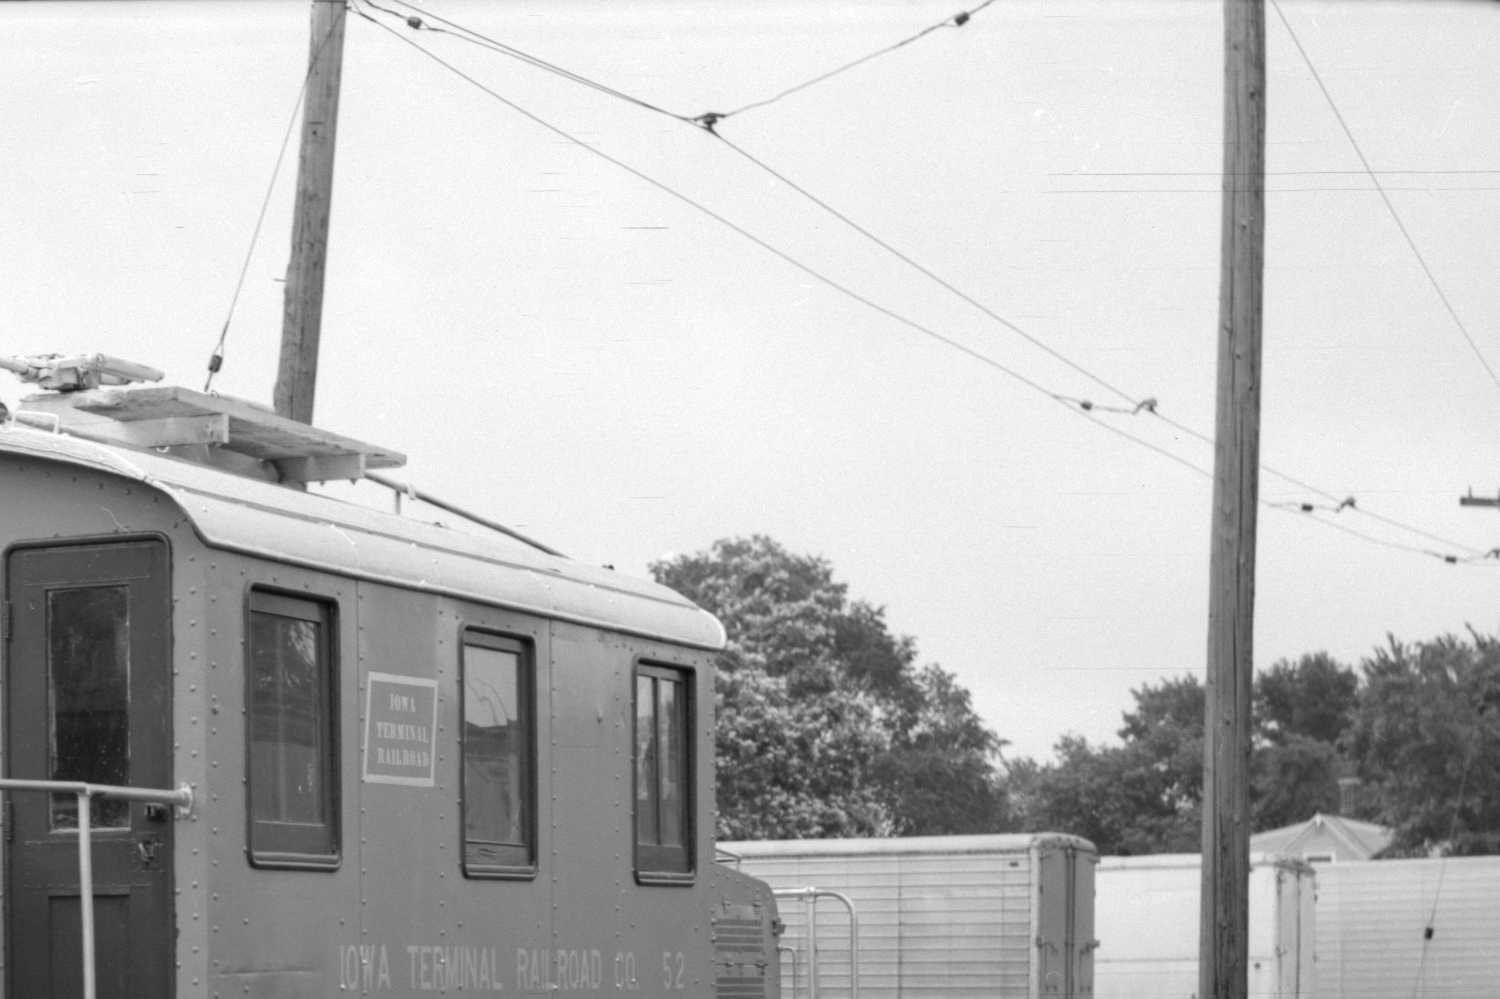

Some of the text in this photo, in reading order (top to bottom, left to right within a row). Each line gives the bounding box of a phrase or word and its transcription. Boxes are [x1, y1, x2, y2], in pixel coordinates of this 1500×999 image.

[389, 693, 416, 712] IOWA
[376, 721, 429, 743] TERMINAL
[377, 747, 429, 767] RAILROAD
[339, 944, 392, 990] IOWA
[406, 945, 503, 990] TERMINAL
[517, 948, 601, 990] RAILROAD
[662, 951, 685, 990] 52
